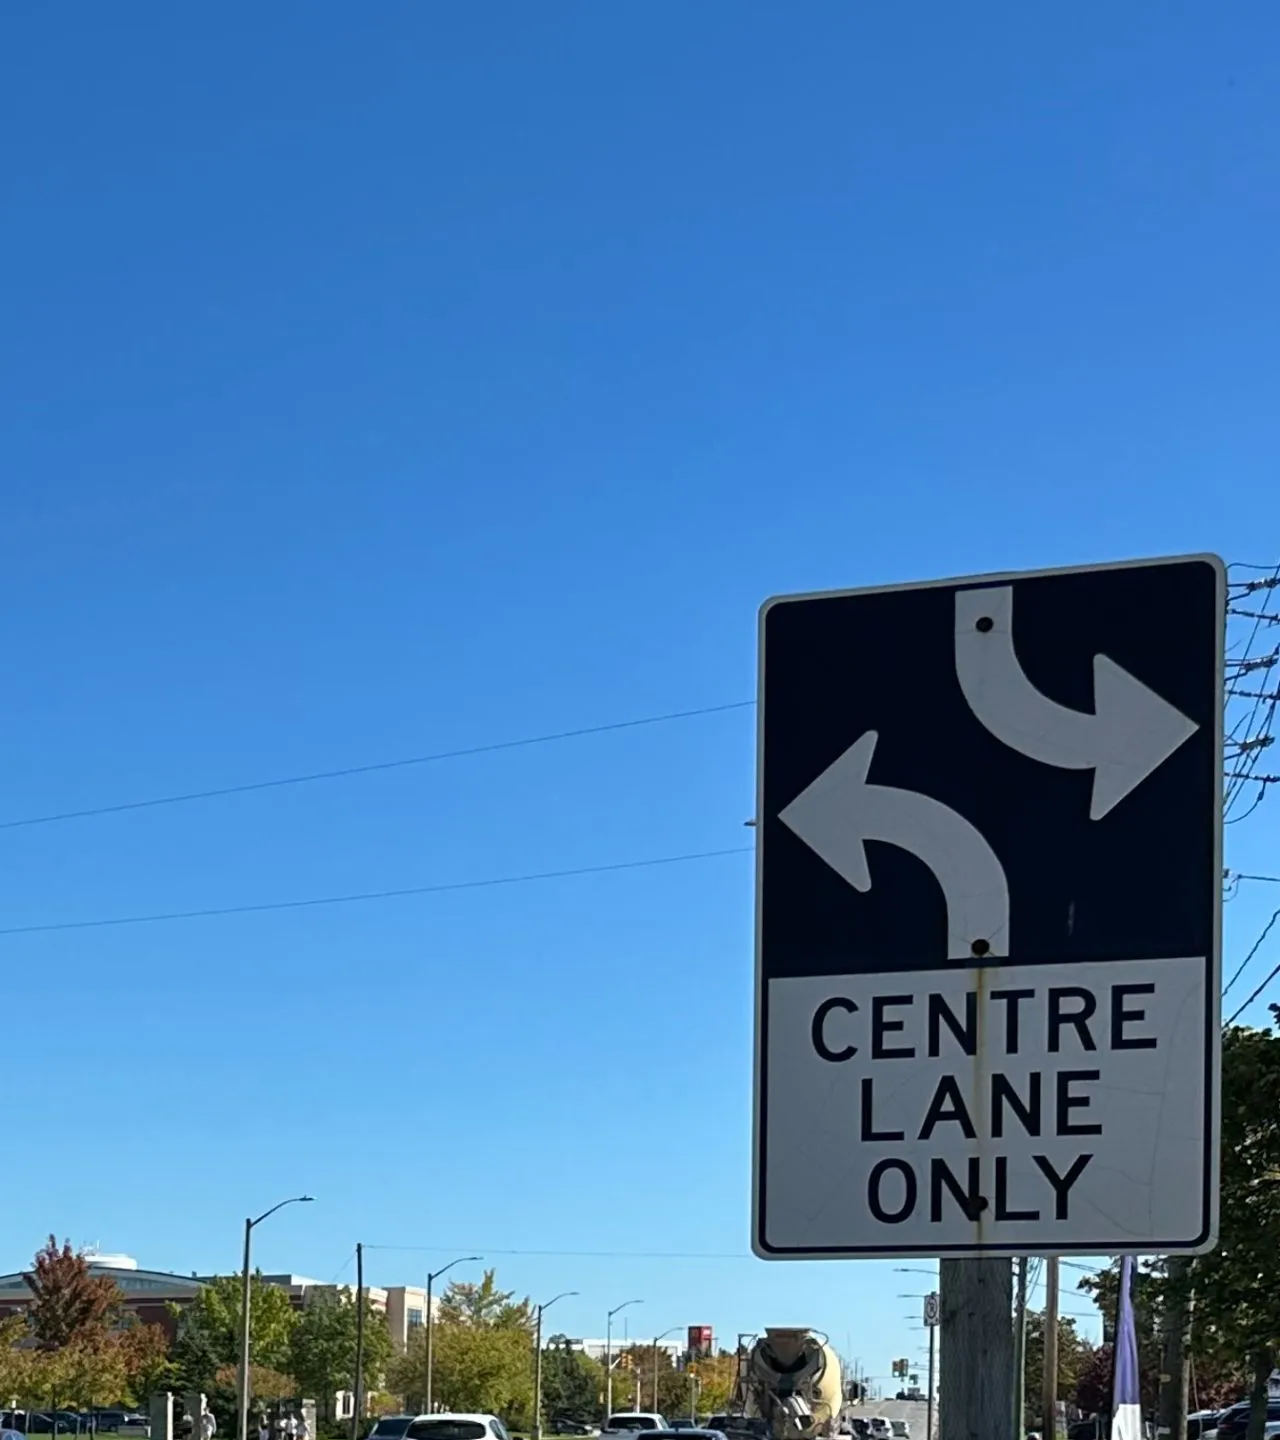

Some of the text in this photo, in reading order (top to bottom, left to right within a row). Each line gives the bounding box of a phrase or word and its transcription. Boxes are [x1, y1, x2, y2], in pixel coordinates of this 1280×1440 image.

[811, 982, 1158, 1063] CENTRE
[861, 1069, 1103, 1142] LANE
[867, 1153, 1093, 1224] ONLY
